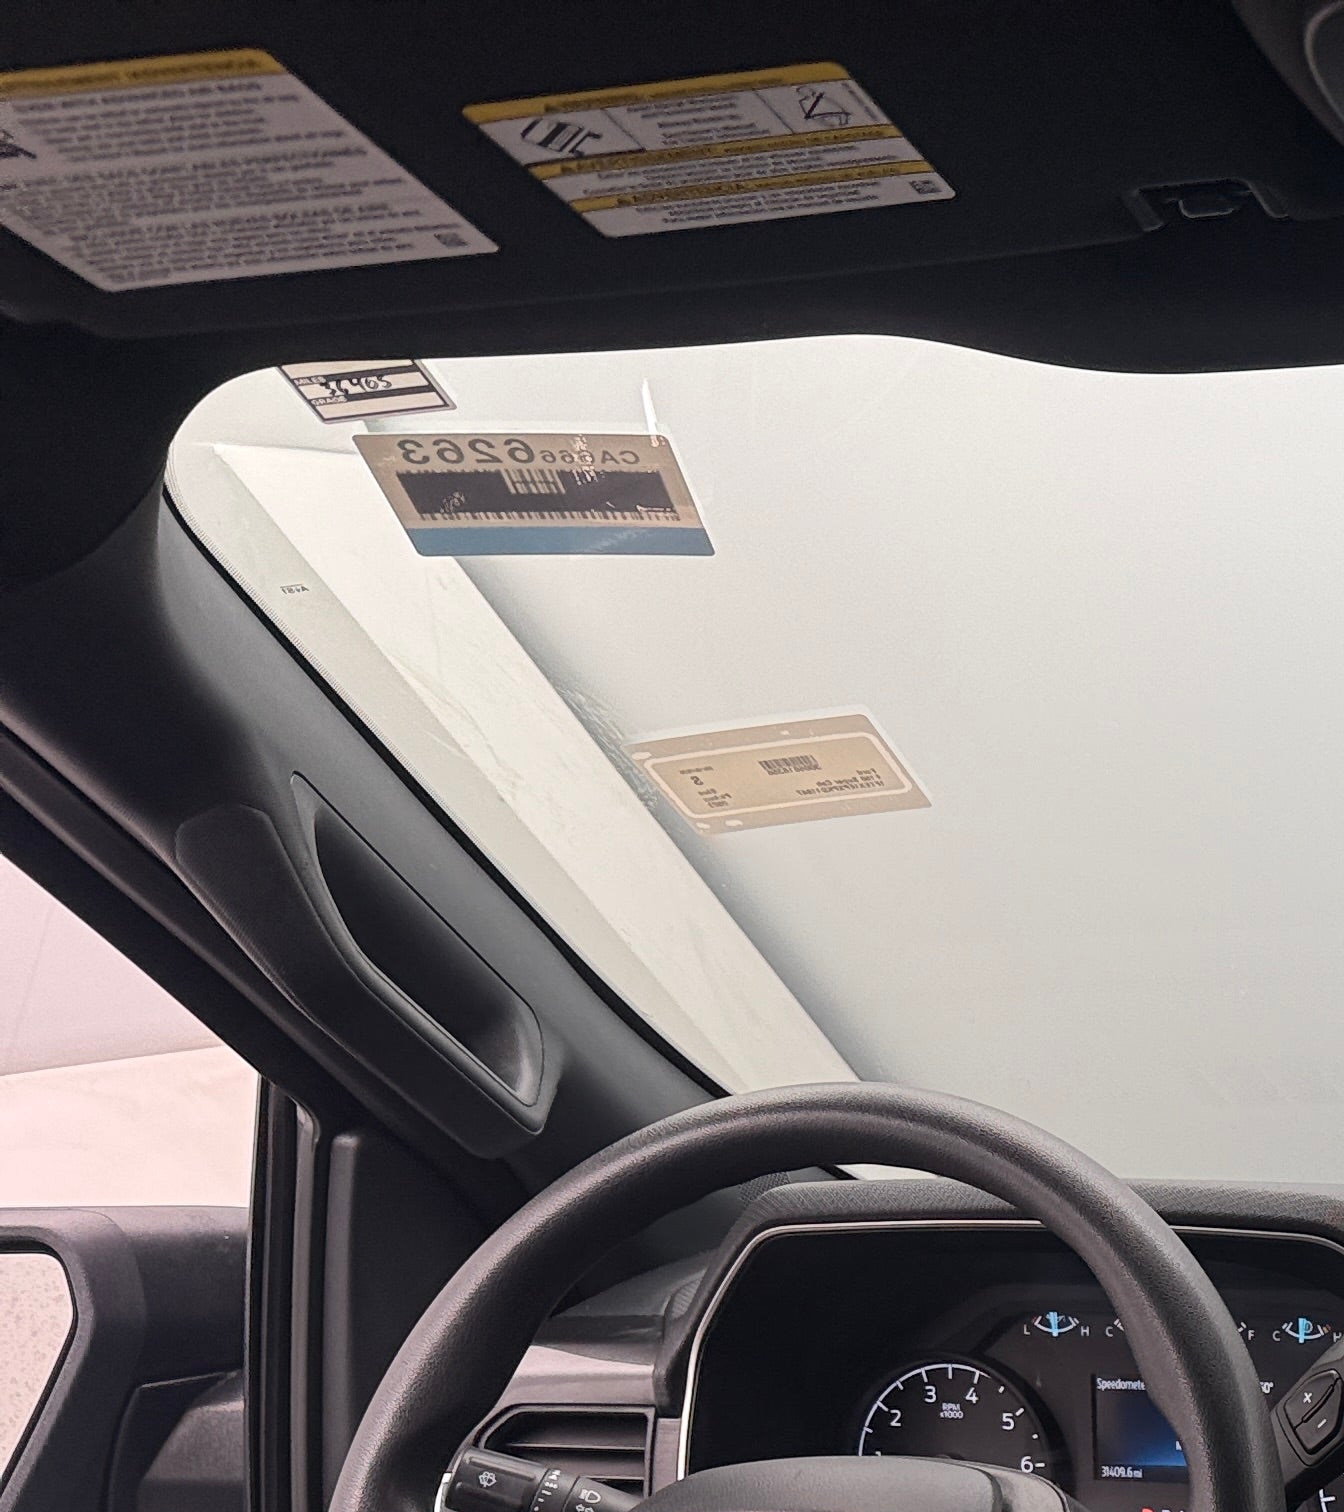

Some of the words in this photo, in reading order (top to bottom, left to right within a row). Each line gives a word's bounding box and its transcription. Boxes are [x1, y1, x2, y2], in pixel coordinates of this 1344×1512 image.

[1023, 1323, 1031, 1335] L
[1080, 1325, 1090, 1337] H
[1105, 1326, 1114, 1337] C
[1248, 1329, 1255, 1340] F
[1272, 1330, 1281, 1341] C
[1096, 1377, 1147, 1392] Speedomete
[924, 1385, 937, 1403] 3
[965, 1387, 979, 1404] 4
[942, 1403, 961, 1411] RPM
[890, 1409, 902, 1427] 2
[1002, 1412, 1015, 1431] 5
[1020, 1455, 1034, 1474] 6
